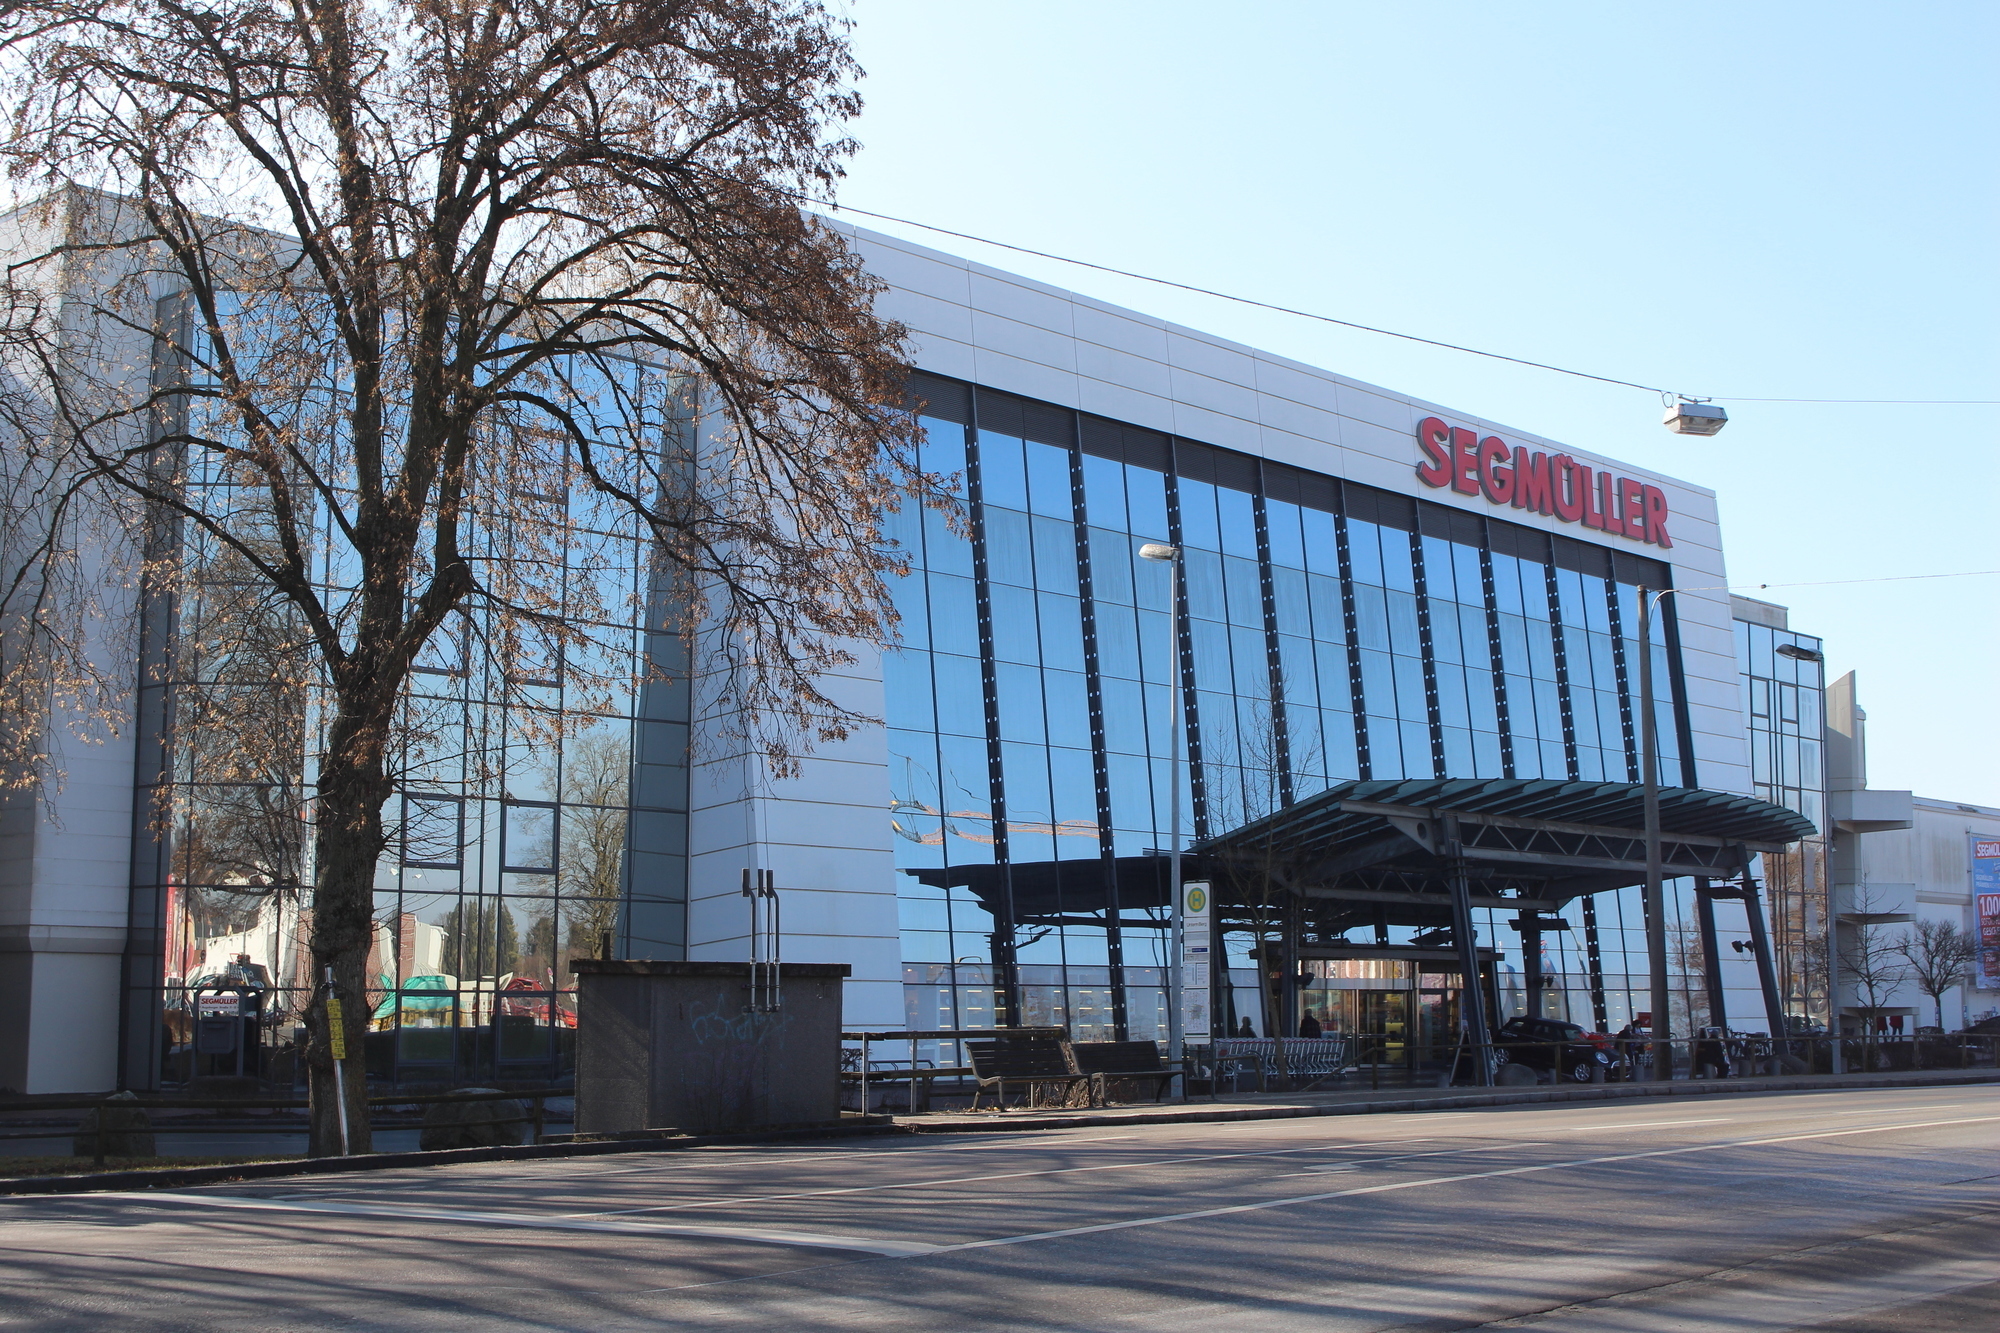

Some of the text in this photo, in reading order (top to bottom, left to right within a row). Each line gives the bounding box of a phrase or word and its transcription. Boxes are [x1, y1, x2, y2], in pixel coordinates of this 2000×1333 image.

[1416, 417, 1673, 549] SEGMÜLLER
[1192, 893, 1202, 907] H
[201, 997, 238, 1005] SEGMÜLLER
